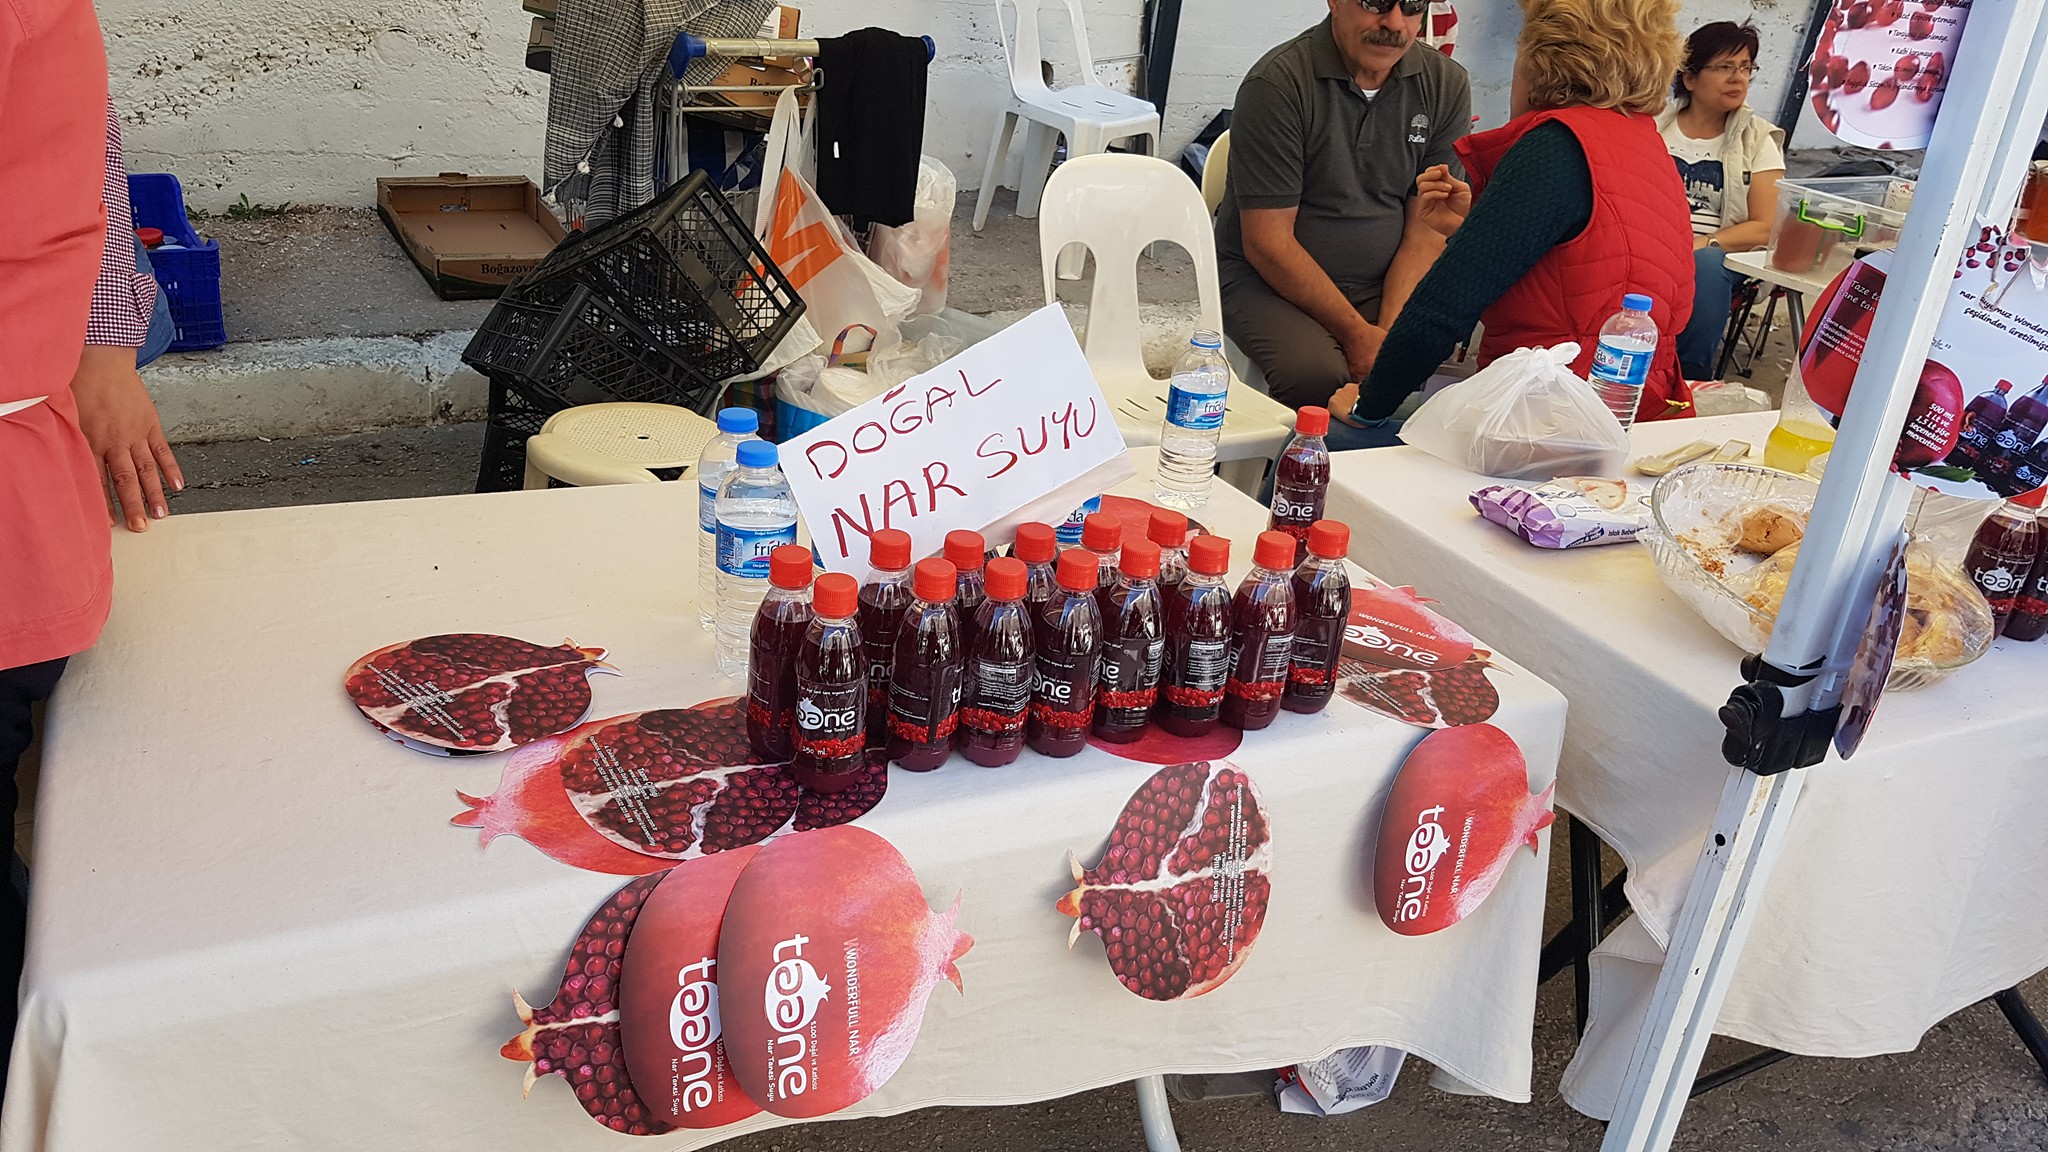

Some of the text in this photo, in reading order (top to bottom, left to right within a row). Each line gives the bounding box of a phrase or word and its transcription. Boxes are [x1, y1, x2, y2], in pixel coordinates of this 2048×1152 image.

[1851, 280, 1870, 296] Taze
[1959, 290, 1976, 301] nar
[1963, 307, 2048, 353] çeşidinden üretilmişt
[1929, 403, 1944, 414] 500
[1932, 414, 1941, 423] Lt
[1941, 419, 1950, 428] ve
[805, 369, 1002, 480] DOĞAL
[1909, 421, 1948, 446] seçenekleri
[1916, 415, 1928, 425] 1,5
[1928, 421, 1938, 430] Lt
[1906, 430, 1942, 453] mevcuttur.
[831, 397, 1097, 558] NAR SUYU
[1358, 612, 1437, 641] WONDERFULL NAR
[802, 746, 814, 754] 250
[1228, 803, 1236, 853] info@taane.com.tr
[1449, 816, 1474, 895] WONDERFULL NAR
[1211, 852, 1221, 903] Taane Çiftliği
[1218, 850, 1227, 903] www.taane.com.tr
[845, 948, 862, 1057] WONDERFULL NAR
[809, 1039, 819, 1056] Doğal
[671, 1058, 679, 1073] Nar
[766, 1039, 776, 1102] Nar Tanesi Suyu
[671, 1074, 679, 1096] Tanesi
